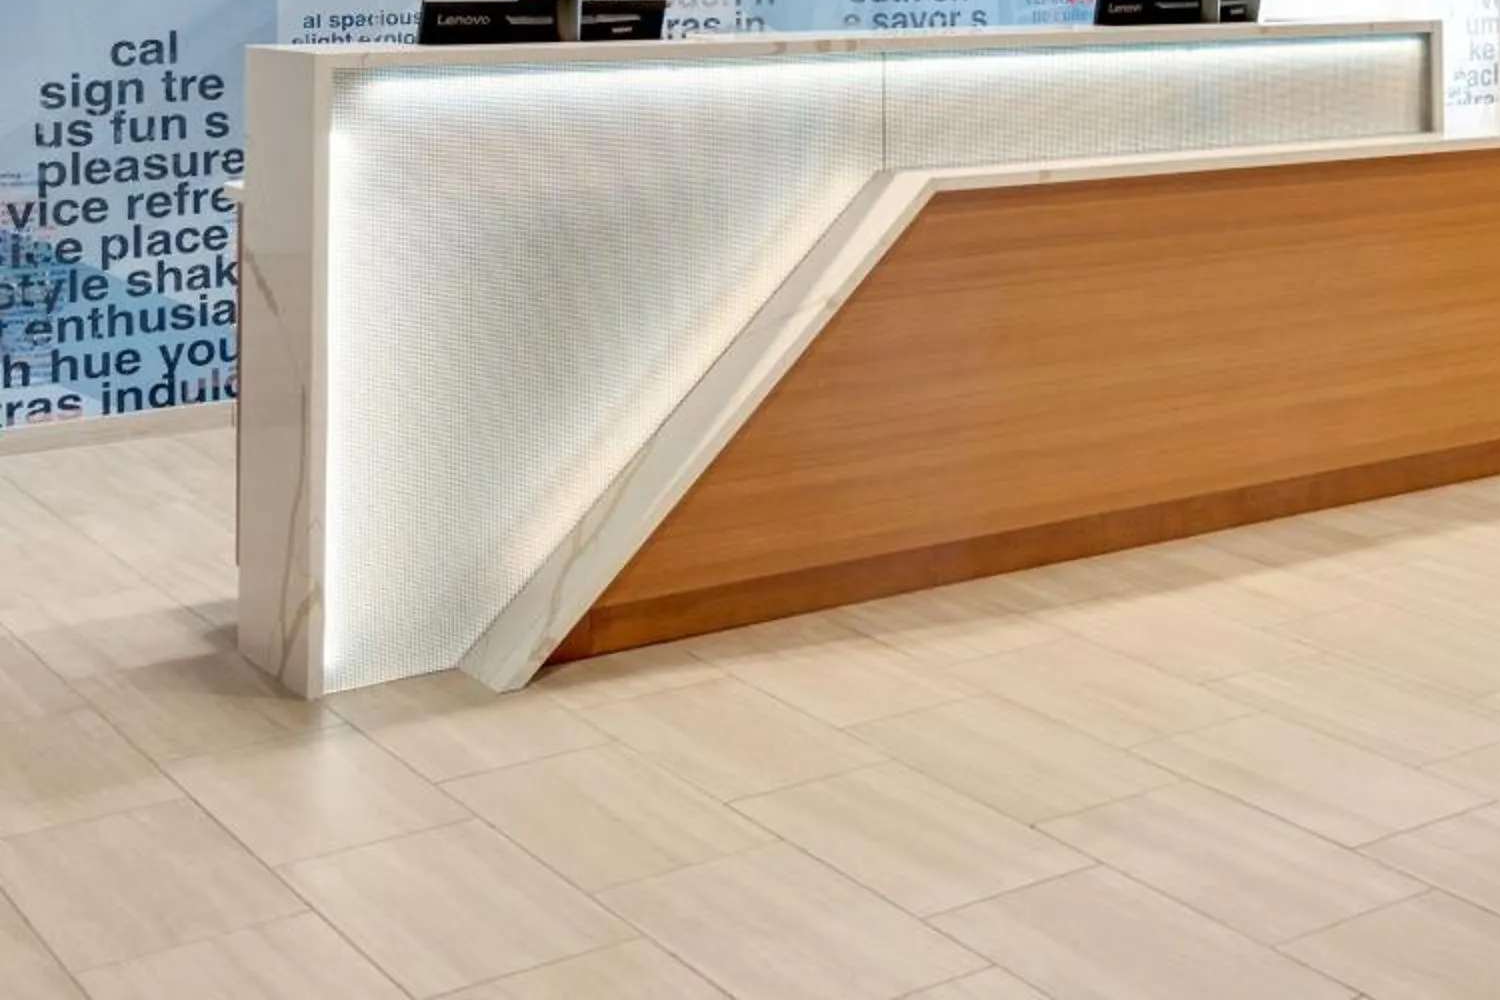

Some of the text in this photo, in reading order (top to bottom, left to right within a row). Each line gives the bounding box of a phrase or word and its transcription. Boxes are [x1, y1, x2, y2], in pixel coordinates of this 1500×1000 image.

[303, 12, 321, 30] al
[437, 12, 491, 26] Lenovo
[110, 30, 178, 68] cal
[39, 69, 225, 118] sign tre
[35, 109, 230, 149] us fun s
[37, 147, 245, 199] pleasure
[7, 181, 236, 232] vice refre
[101, 224, 229, 271] place
[126, 256, 239, 299] shak
[25, 292, 237, 346] enthusia
[3, 335, 239, 389] h hue you
[0, 391, 83, 428] ras
